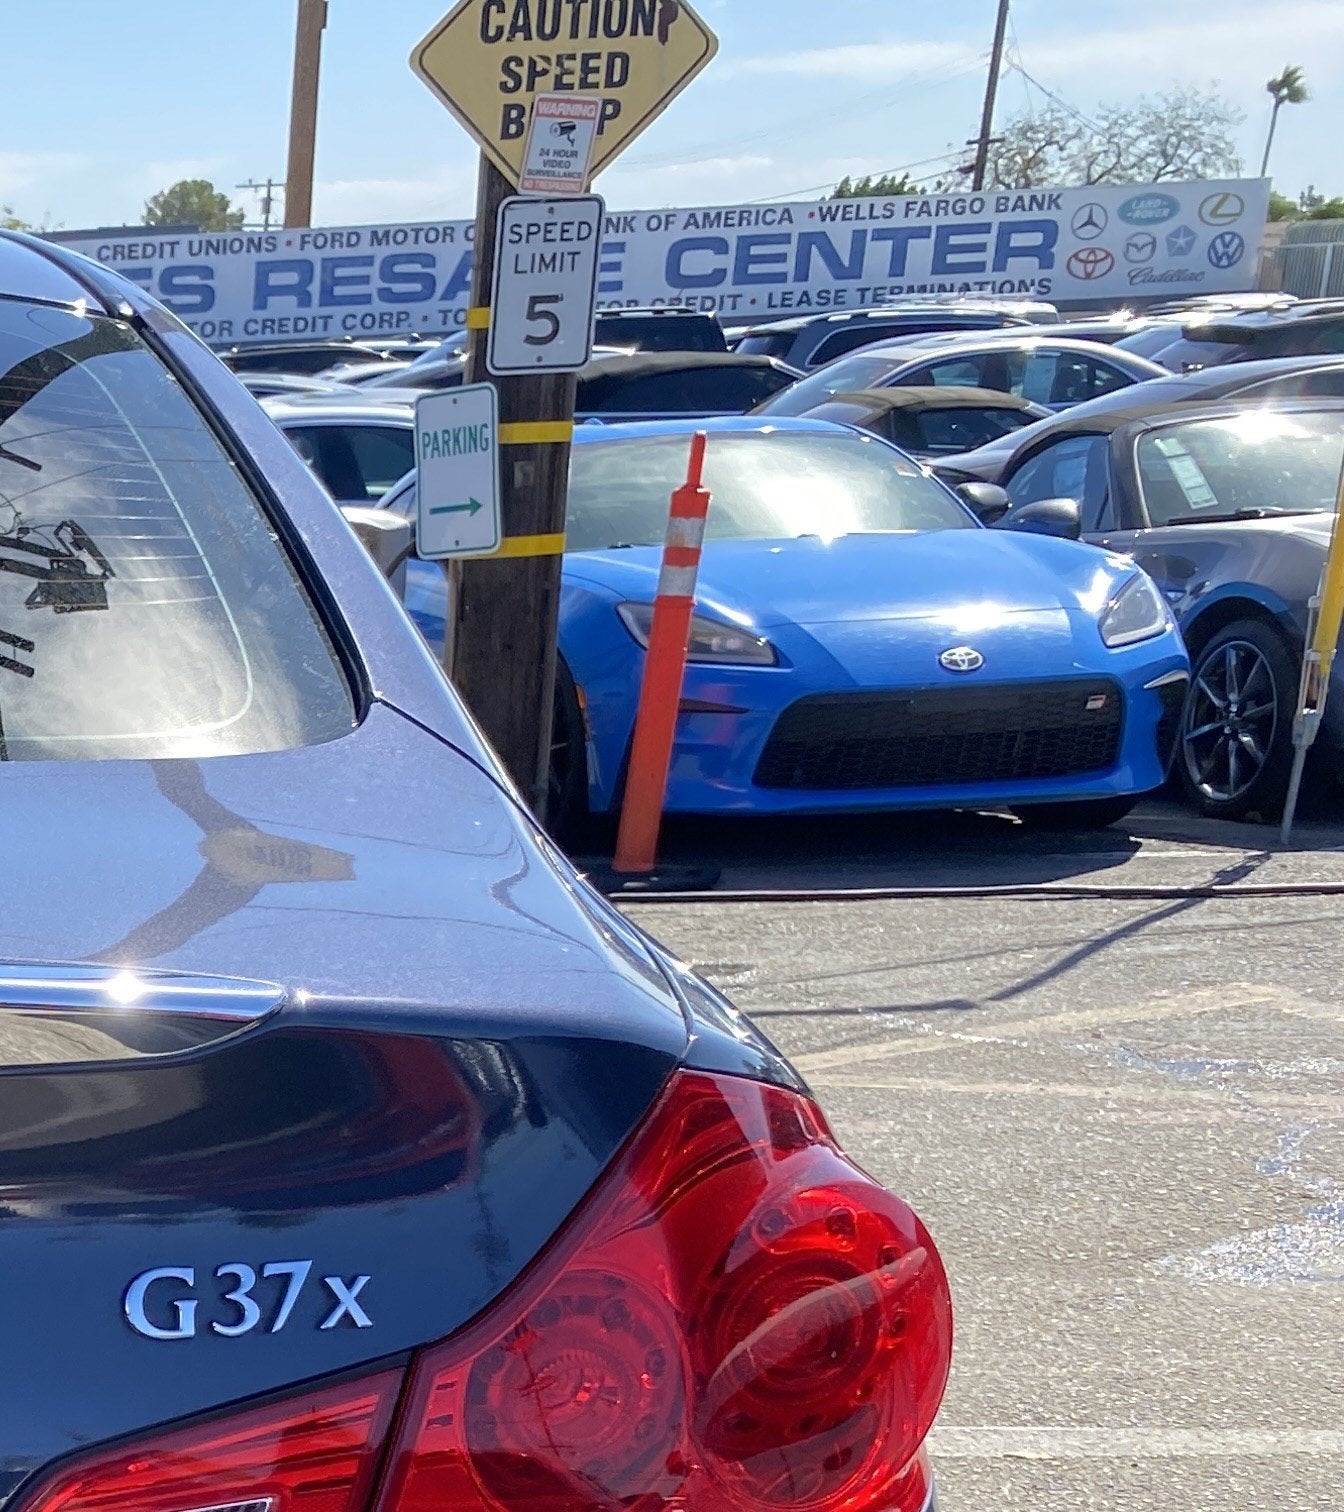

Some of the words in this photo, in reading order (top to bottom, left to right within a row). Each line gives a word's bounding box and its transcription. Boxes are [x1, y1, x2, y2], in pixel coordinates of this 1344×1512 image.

[499, 52, 630, 94] SPEED
[500, 99, 621, 140] BP
[538, 101, 596, 117] WARNING
[538, 148, 550, 157] 24
[552, 149, 579, 158] HOUR
[542, 159, 572, 169] VIDEO
[646, 212, 678, 232] OF
[682, 207, 794, 230] AMERICA
[818, 201, 896, 222] WELLS
[904, 197, 986, 218] FARGO
[995, 192, 1064, 214] BANK
[97, 240, 180, 262] CREDIT
[188, 236, 277, 258] UNIONS
[299, 231, 361, 251] FORD
[369, 226, 455, 247] MOTOR
[508, 220, 593, 245] SPEED
[514, 251, 581, 275] LIMIT
[665, 218, 1059, 290] CENTER
[767, 289, 847, 309] LEASE
[244, 316, 333, 336] CREDIT
[341, 311, 412, 331] CORP.
[522, 292, 563, 346] 5
[421, 423, 490, 460] PARKING
